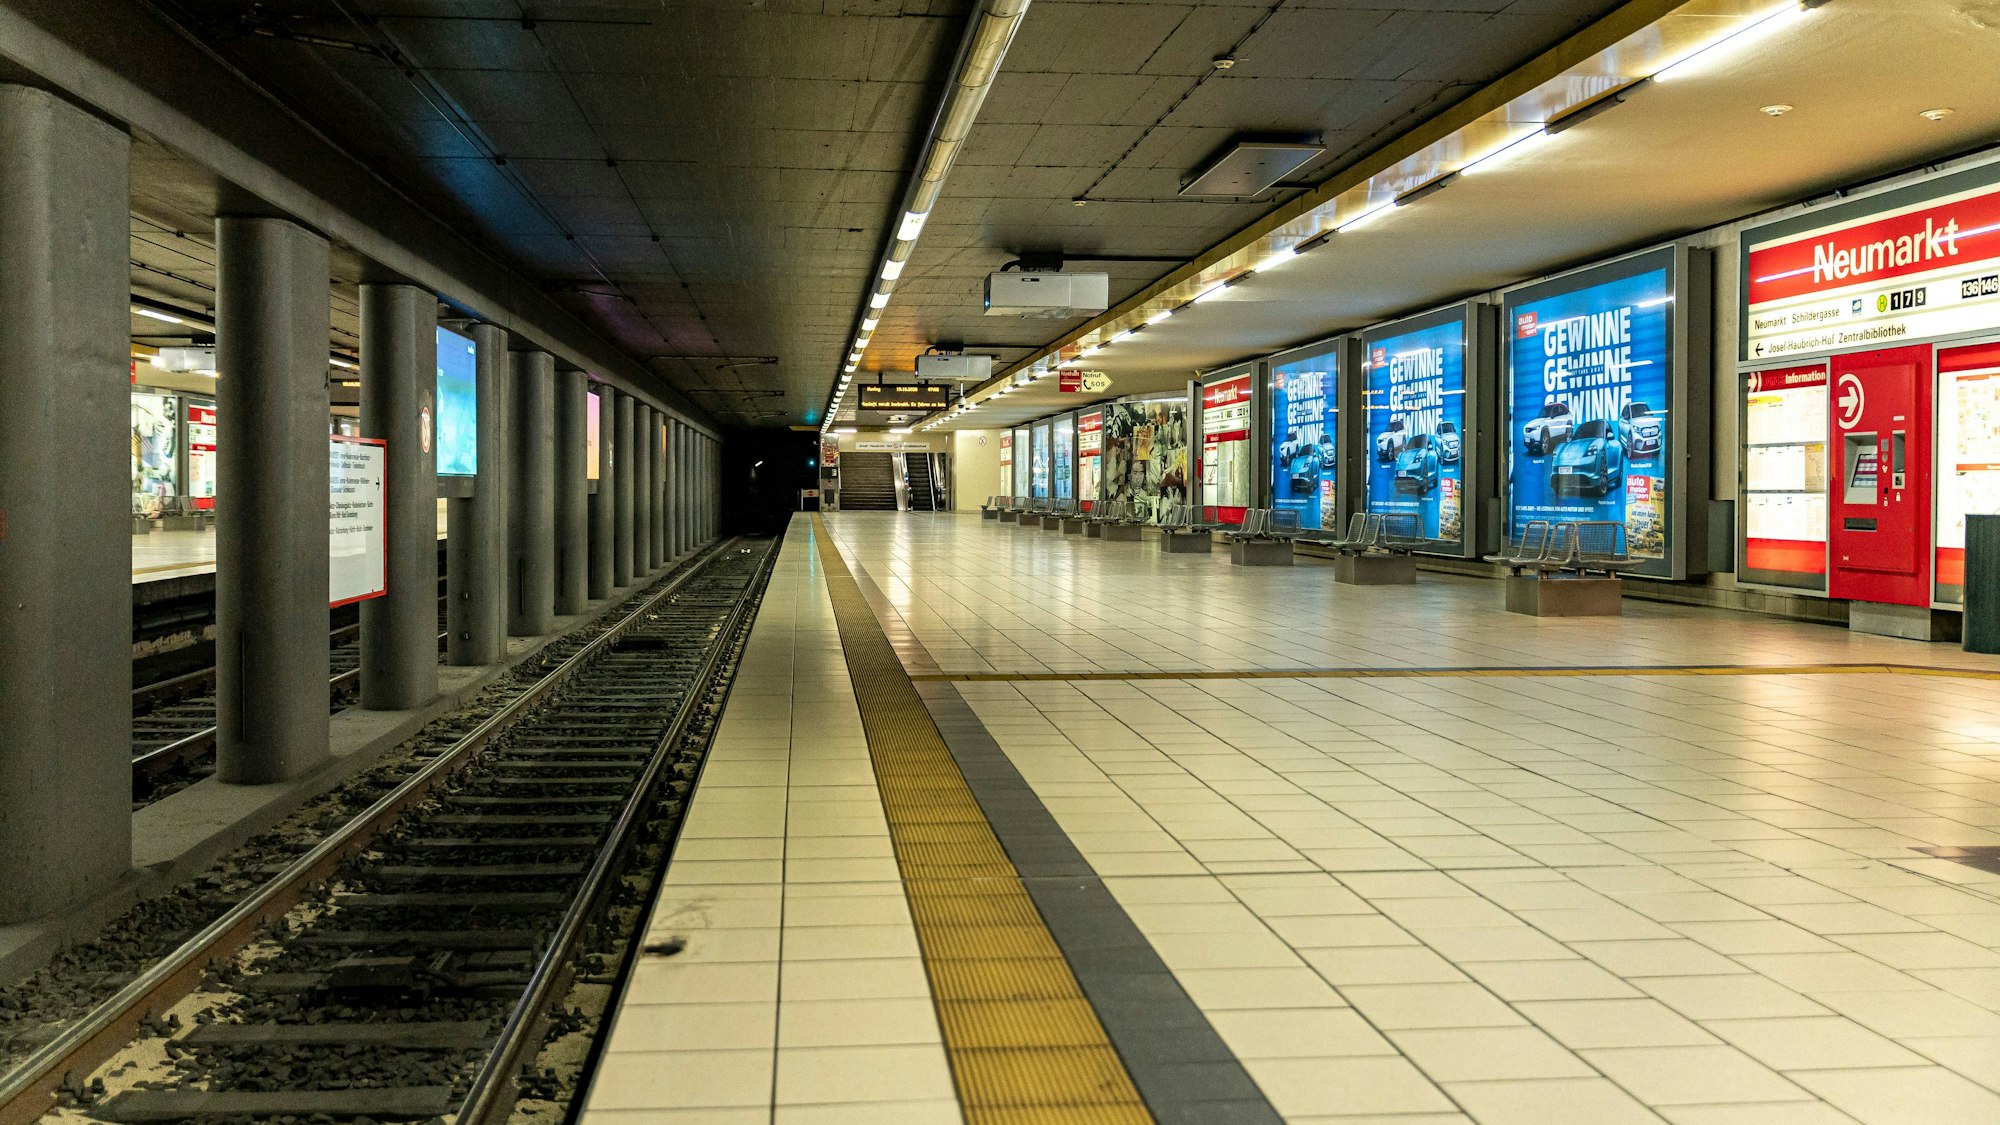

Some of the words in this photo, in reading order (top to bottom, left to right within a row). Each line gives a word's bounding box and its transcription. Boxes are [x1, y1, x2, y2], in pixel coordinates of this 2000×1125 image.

[1814, 218, 1958, 283] Neumarkt
[1893, 295, 1899, 308] 1
[1904, 292, 1911, 306] 7
[1917, 290, 1924, 304] 9
[1962, 280, 1978, 297] 136
[1981, 277, 1998, 294] 146
[1518, 315, 1533, 325] auto
[1754, 316, 1786, 330] Neumarkt
[1792, 308, 1840, 324] Schildergasse
[1543, 307, 1631, 357] GEWINNE
[1768, 334, 1835, 354] Josef-Haubrich-Hof
[1838, 323, 1906, 344] Zentralbibliothek
[1390, 347, 1443, 384] GEWINNE
[1543, 346, 1632, 393] GEWINNE
[1785, 370, 1826, 385] Information
[1214, 383, 1238, 404] Neumarkt
[1287, 373, 1324, 402] GEWINNE
[1390, 377, 1443, 412] GEWINNE
[1287, 399, 1324, 426] GEWINNE
[1627, 477, 1645, 487] auto
[1629, 486, 1648, 494] motor
